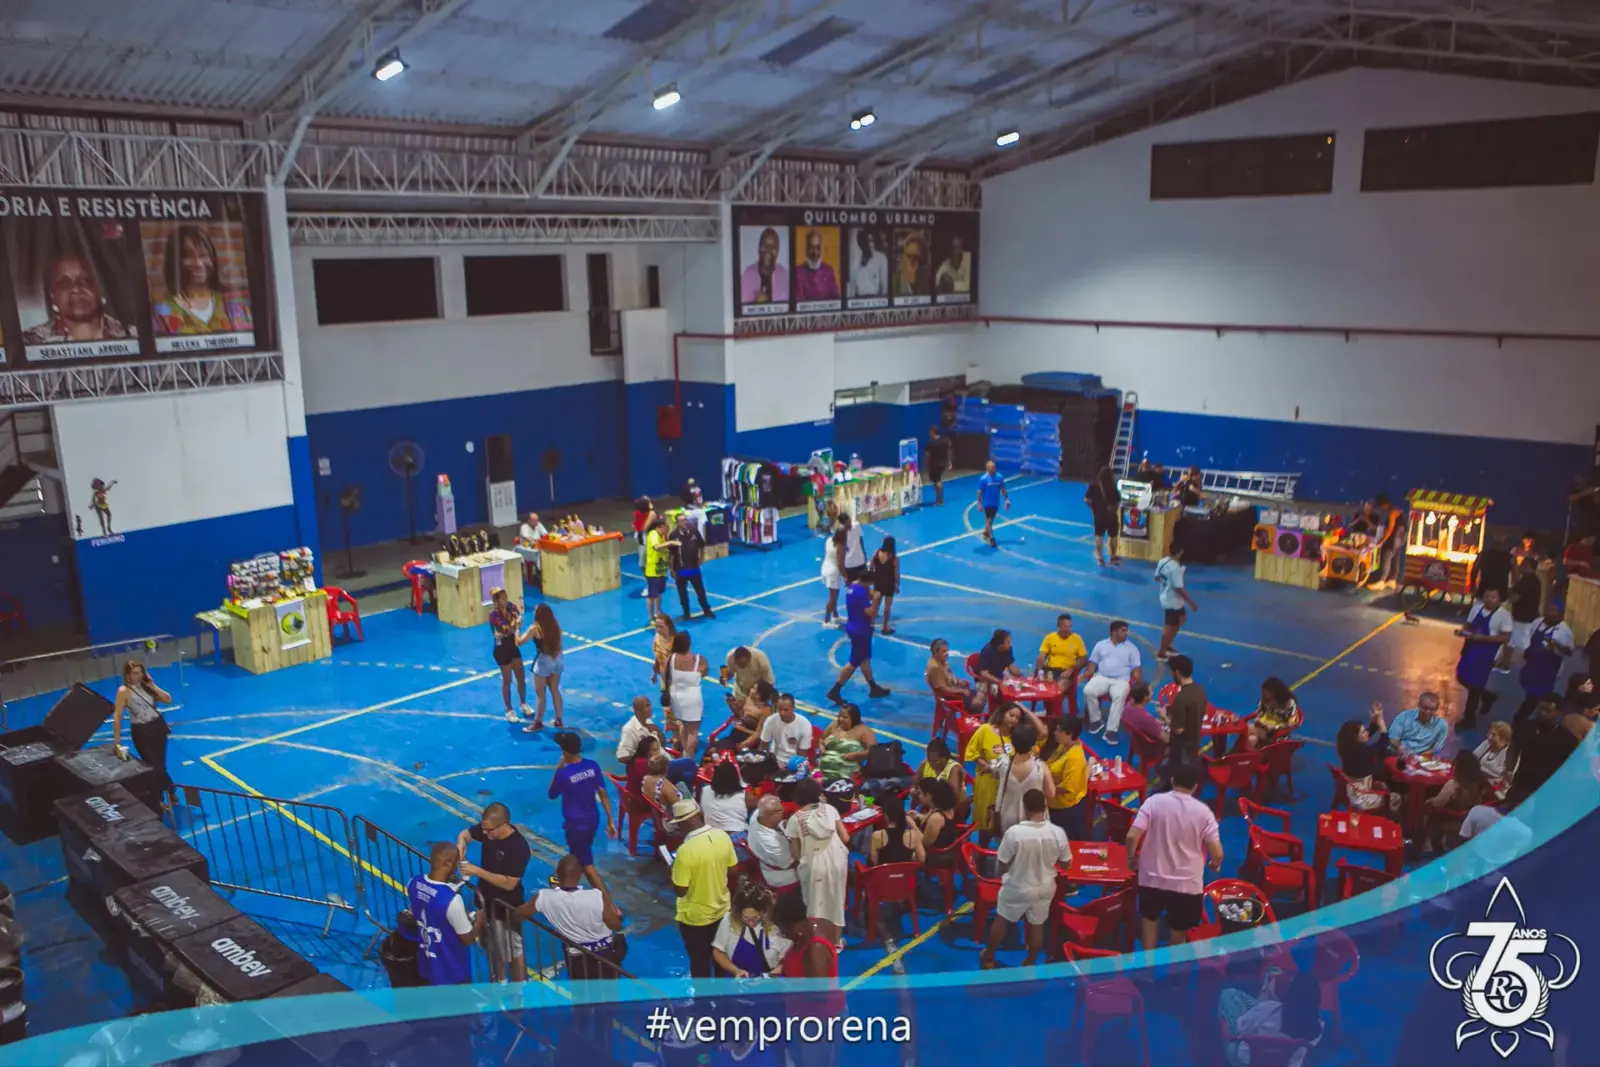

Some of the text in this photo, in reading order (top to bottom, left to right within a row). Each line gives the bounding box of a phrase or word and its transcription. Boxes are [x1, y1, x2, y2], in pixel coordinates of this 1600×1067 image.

[58, 196, 72, 217] E
[79, 193, 212, 217] RESISTÊNCIA
[804, 210, 935, 225] QUILOMBO URBANO
[40, 346, 94, 359] SEBASTIANA
[85, 796, 125, 822] ambev
[151, 885, 200, 920] ambev
[211, 937, 272, 977] ambev
